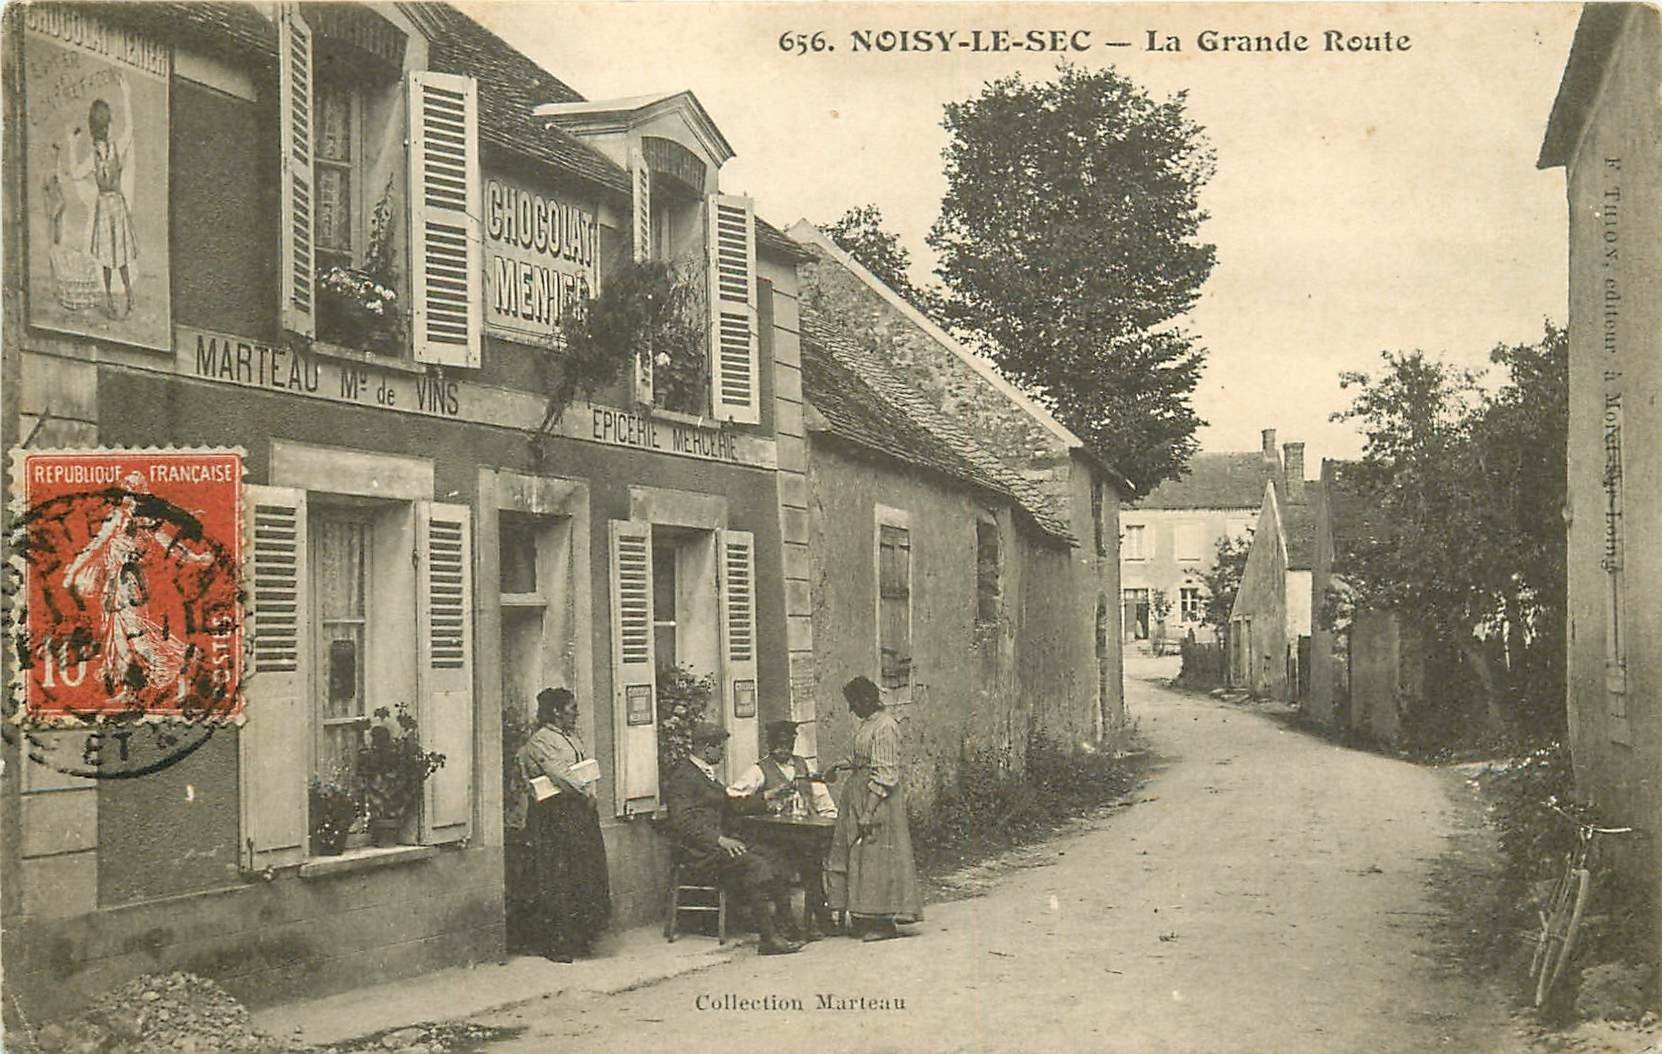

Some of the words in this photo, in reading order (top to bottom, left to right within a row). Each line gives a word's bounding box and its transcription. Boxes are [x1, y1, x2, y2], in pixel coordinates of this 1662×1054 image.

[487, 179, 594, 268] CHOCOLAT
[197, 335, 319, 393] MARTEAU
[377, 376, 396, 406] de
[417, 376, 460, 416] VINS
[592, 409, 660, 449] EPICERIE
[672, 428, 738, 461] MERCERIE
[150, 463, 232, 485] FRANÇAISE
[36, 635, 88, 688] 10
